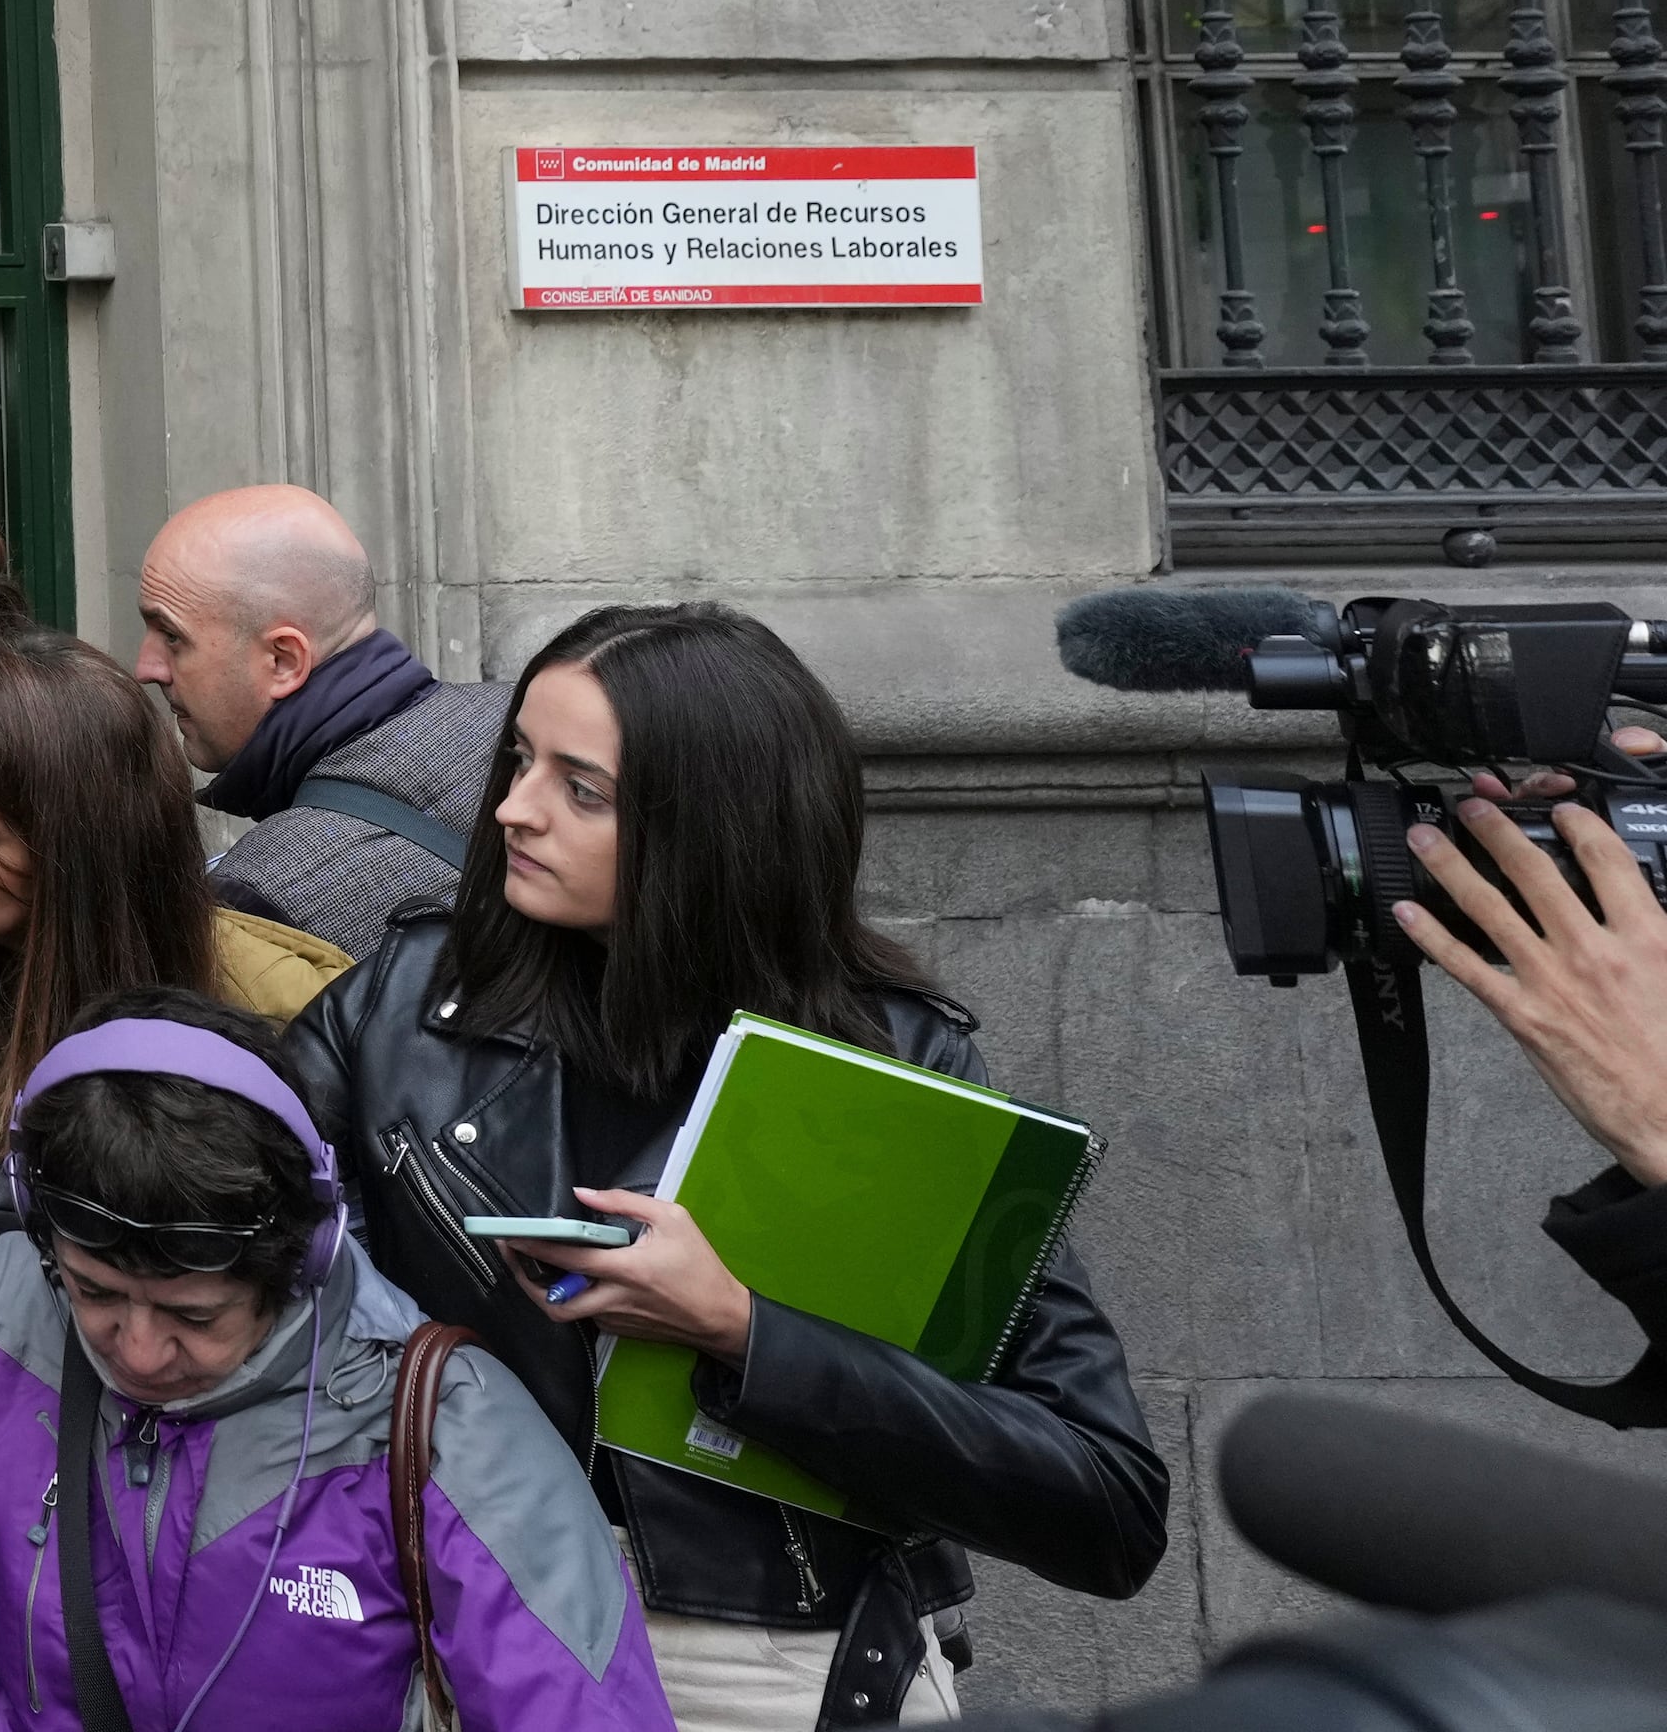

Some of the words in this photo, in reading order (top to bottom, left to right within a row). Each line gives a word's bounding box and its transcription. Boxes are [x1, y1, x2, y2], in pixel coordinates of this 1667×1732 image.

[572, 155, 673, 172] Comunidad
[677, 156, 700, 172] de
[705, 155, 766, 171] Madrid
[536, 202, 654, 225] Dirección
[662, 202, 759, 224] General
[766, 201, 797, 223] de
[806, 202, 926, 223] Recursos
[538, 238, 654, 261] Humanos
[664, 243, 677, 265] y
[687, 237, 823, 259] Relaciones
[831, 236, 958, 259] Laborales
[631, 289, 649, 302] DE
[652, 288, 712, 303] SANIDAD
[1626, 823, 1667, 832] XDCA
[298, 1564, 333, 1586] THE
[269, 1576, 333, 1606] NORTH
[287, 1594, 334, 1619] FACE
